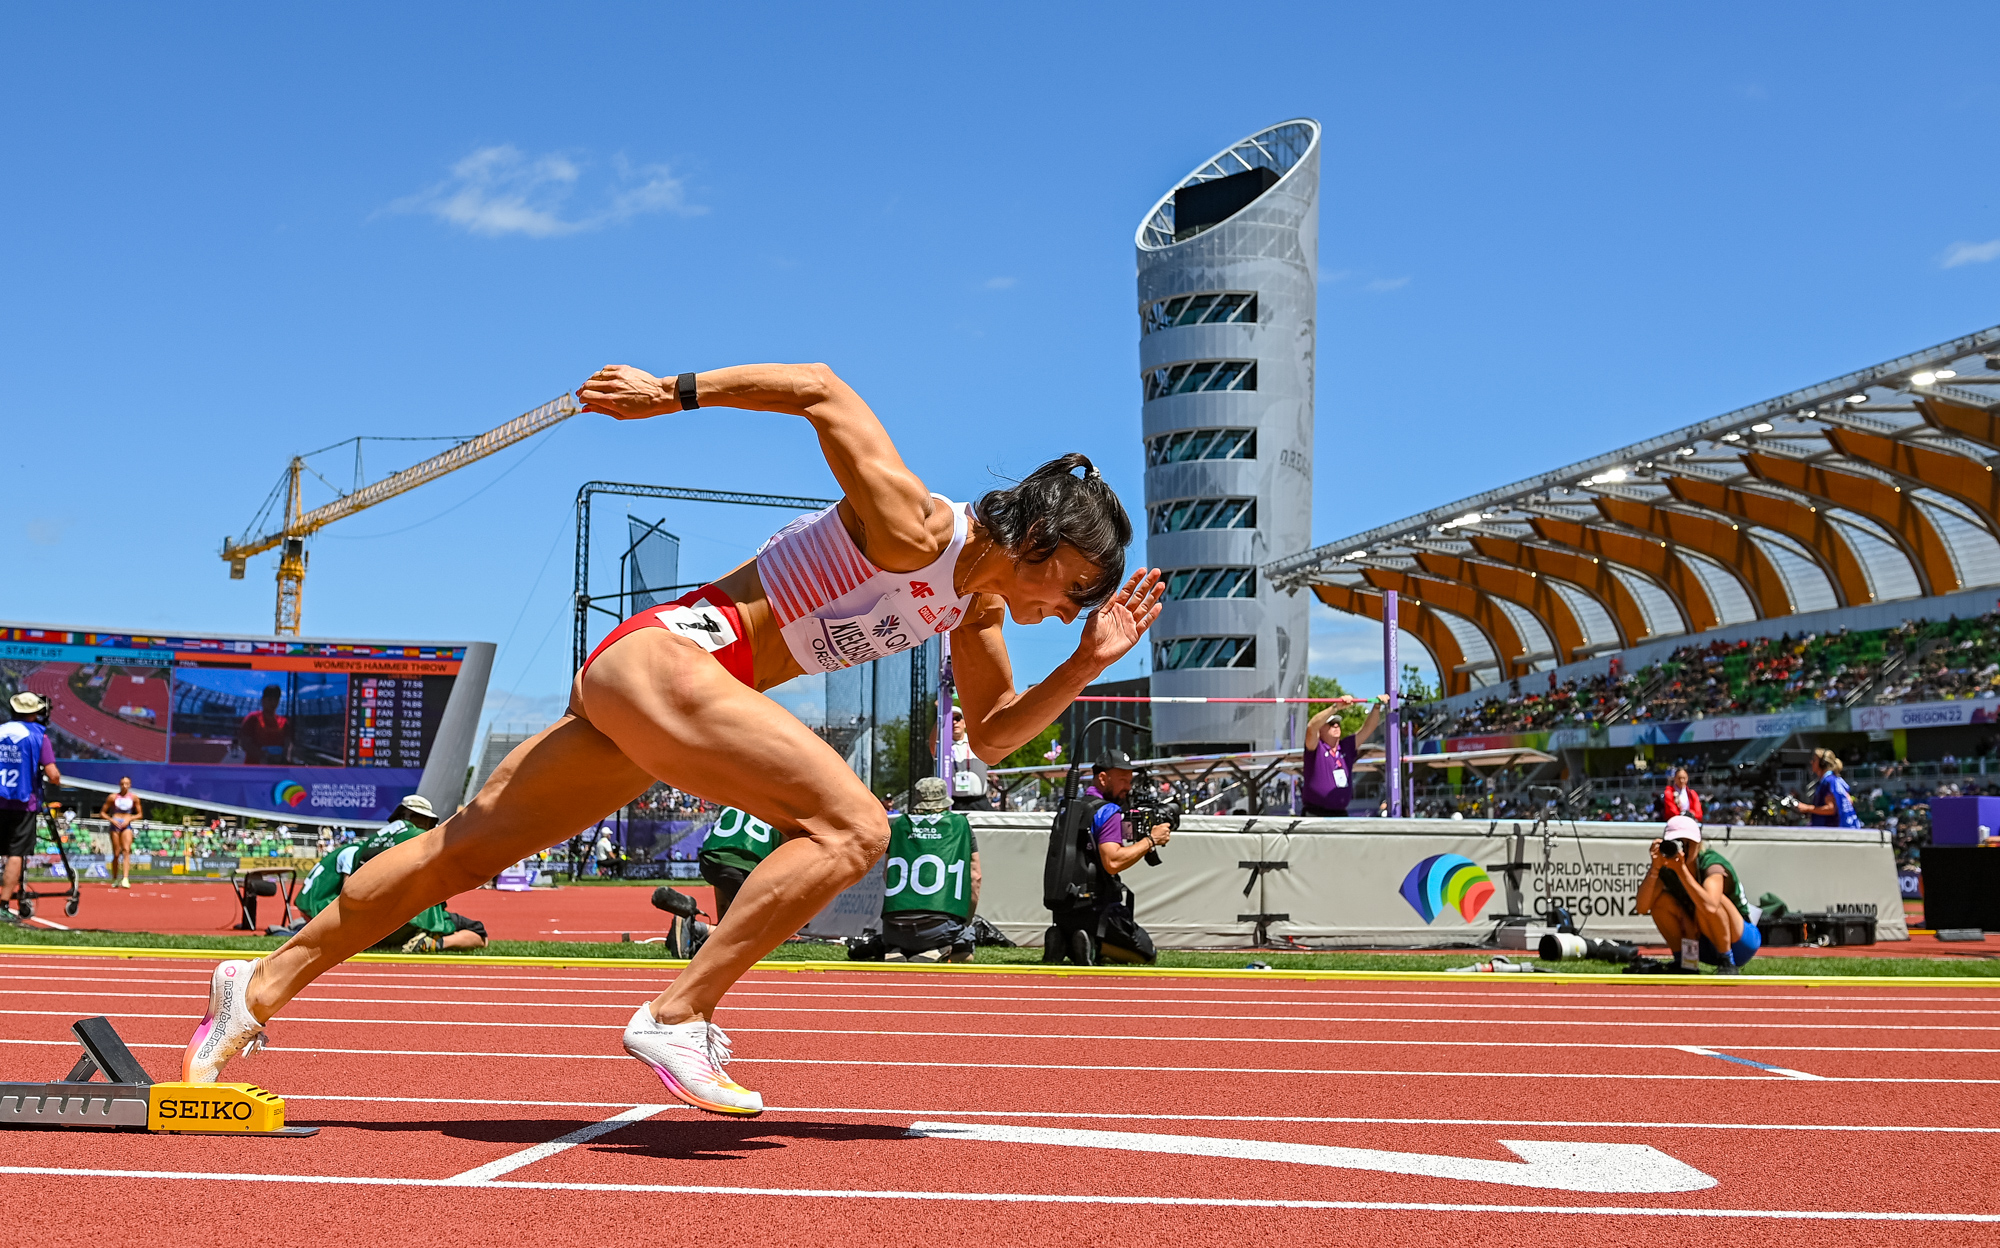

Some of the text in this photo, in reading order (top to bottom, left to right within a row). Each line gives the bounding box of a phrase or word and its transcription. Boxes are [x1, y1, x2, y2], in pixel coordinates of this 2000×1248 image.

[909, 581, 935, 598] 4F
[920, 607, 935, 624] ORLEN
[6, 647, 63, 657] START LIST
[313, 661, 447, 672] WOMEN'S HAMMER THROW
[378, 680, 396, 688] AND
[352, 689, 423, 699] 2 ROG 75.52
[352, 699, 358, 707] 3
[376, 699, 394, 708] KAS
[376, 709, 394, 717] FAN
[350, 719, 357, 727] 5
[350, 729, 357, 737] 6
[374, 749, 392, 757] LUO
[0, 768, 19, 787] 12
[1533, 862, 1581, 876] WORLD
[885, 853, 965, 901] 001
[1836, 903, 1878, 915] MONDO
[223, 980, 234, 1012] new
[197, 1011, 232, 1060] balance
[159, 1099, 252, 1121] SEIKO
